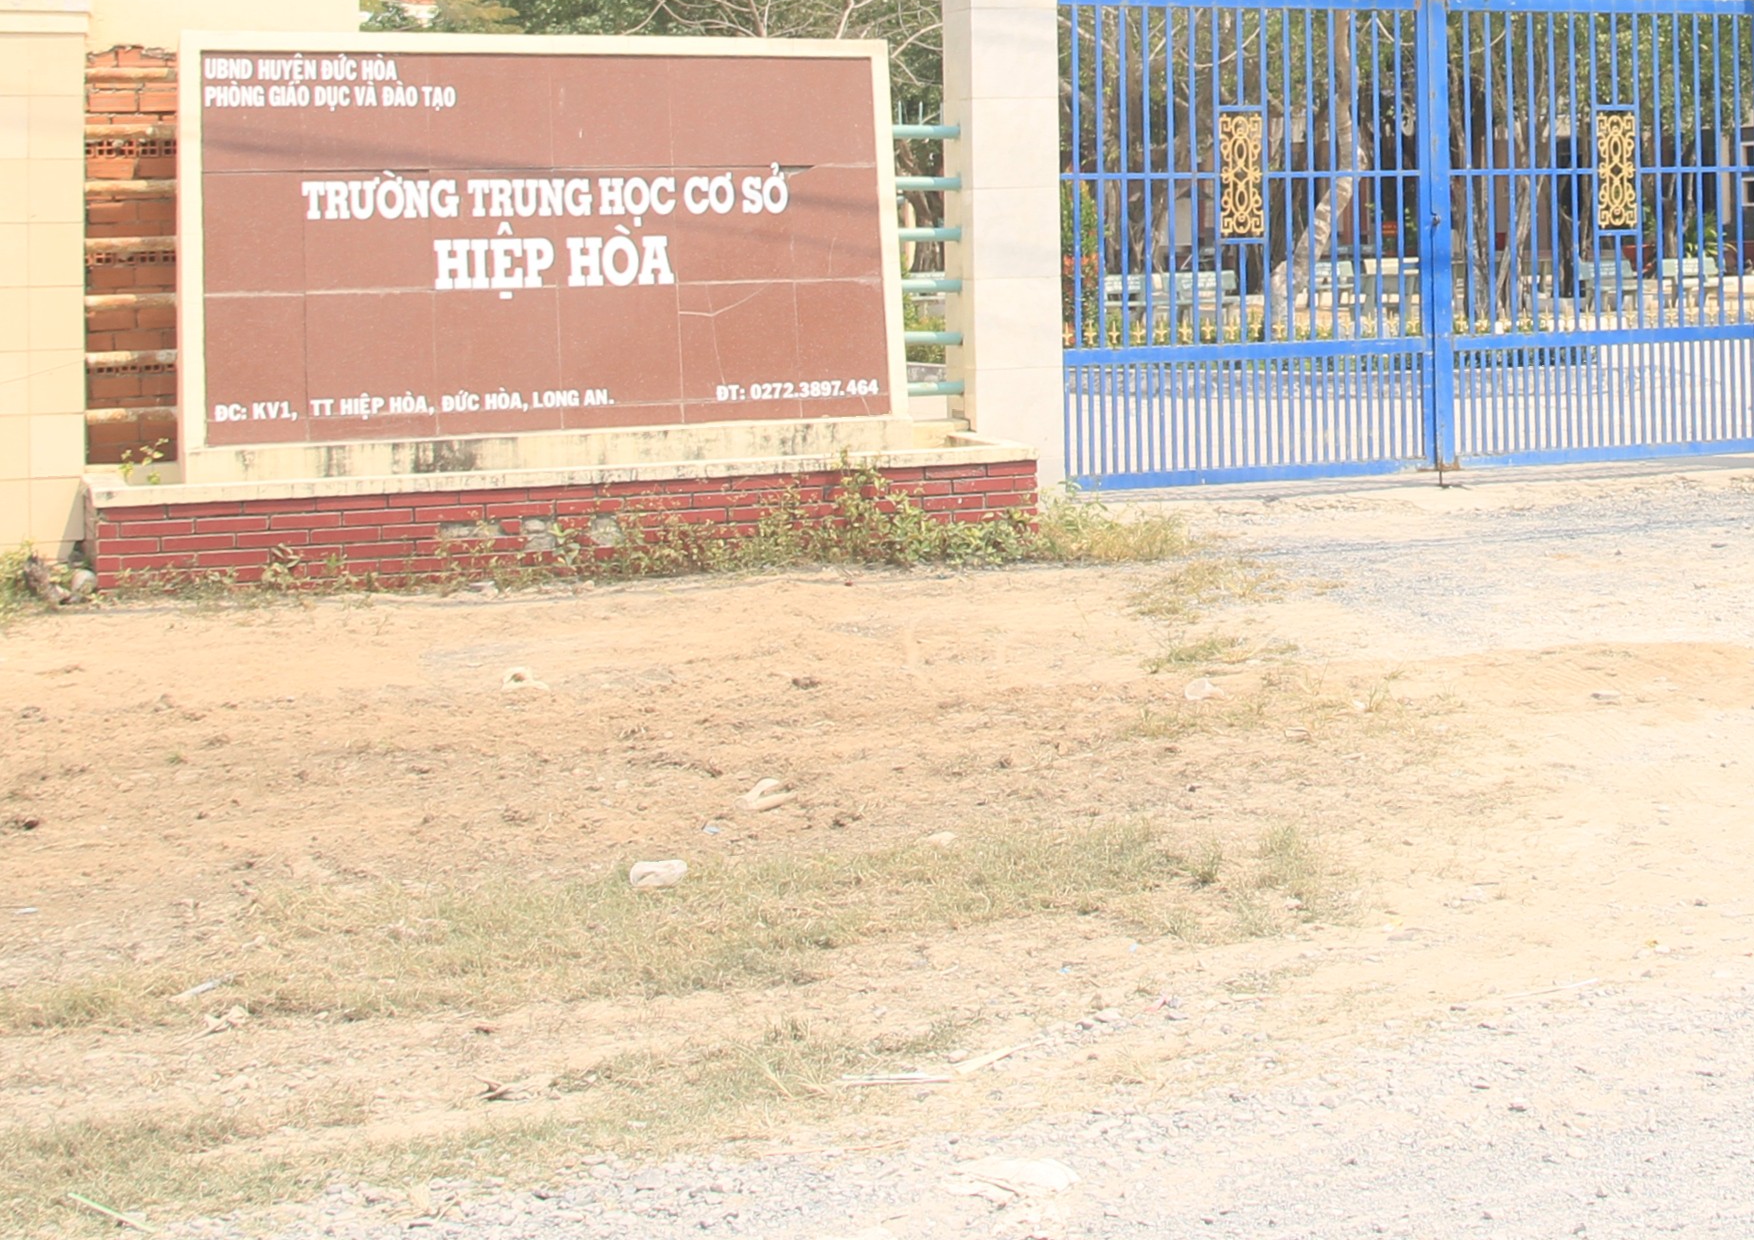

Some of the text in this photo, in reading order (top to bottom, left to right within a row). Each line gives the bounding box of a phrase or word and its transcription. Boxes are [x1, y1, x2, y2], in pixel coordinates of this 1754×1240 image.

[204, 53, 397, 84] UBND HUYỆN ĐỨC HÒA
[204, 80, 456, 111] PHÒNG GIÁO DỤC VÀ ĐÀO TẠO
[302, 162, 789, 227] TRƯỜNG TRUNG HỌC CƠ SỞ
[434, 221, 675, 299] HIỆP HÒA
[214, 387, 615, 422] ĐC: KV1, TT HIỆP HÒA, ĐỨC HÒA, LONG AN.
[716, 379, 879, 401] ĐT: 0272.3897.464
